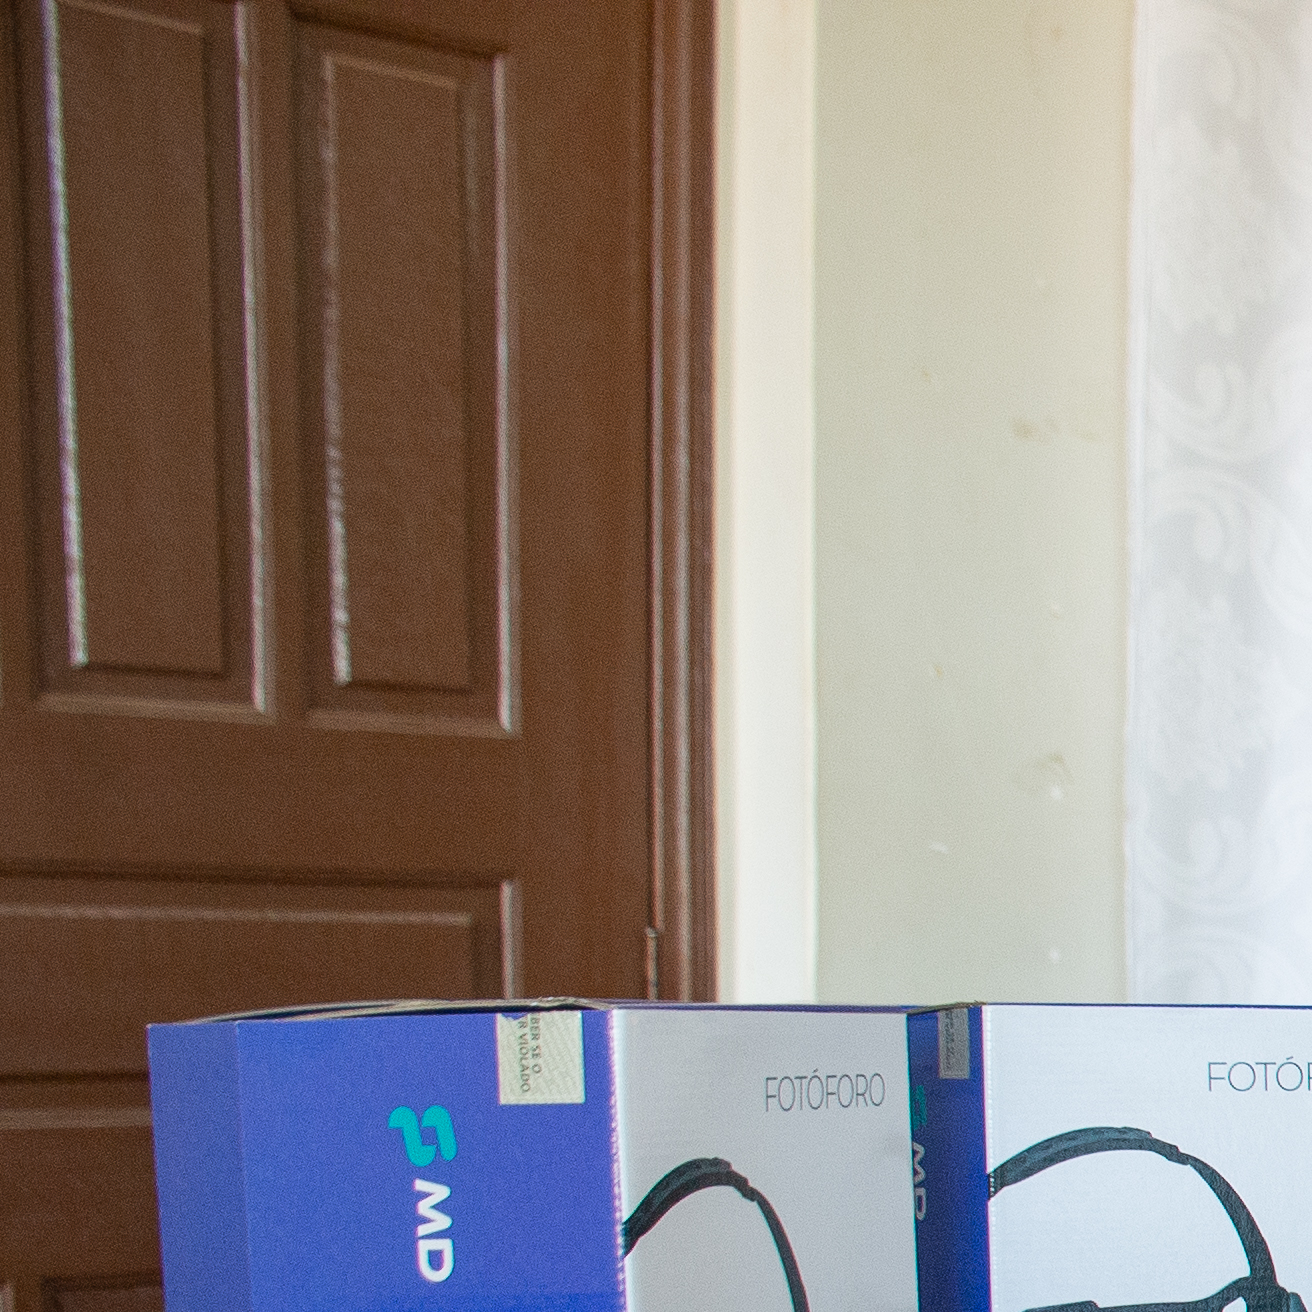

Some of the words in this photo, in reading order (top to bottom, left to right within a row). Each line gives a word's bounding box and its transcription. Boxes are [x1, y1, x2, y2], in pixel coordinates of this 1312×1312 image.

[531, 1014, 542, 1041] BER
[518, 1033, 531, 1094] VIOLADO
[764, 1069, 887, 1113] FOTÓFORO
[413, 1178, 456, 1284] MD
